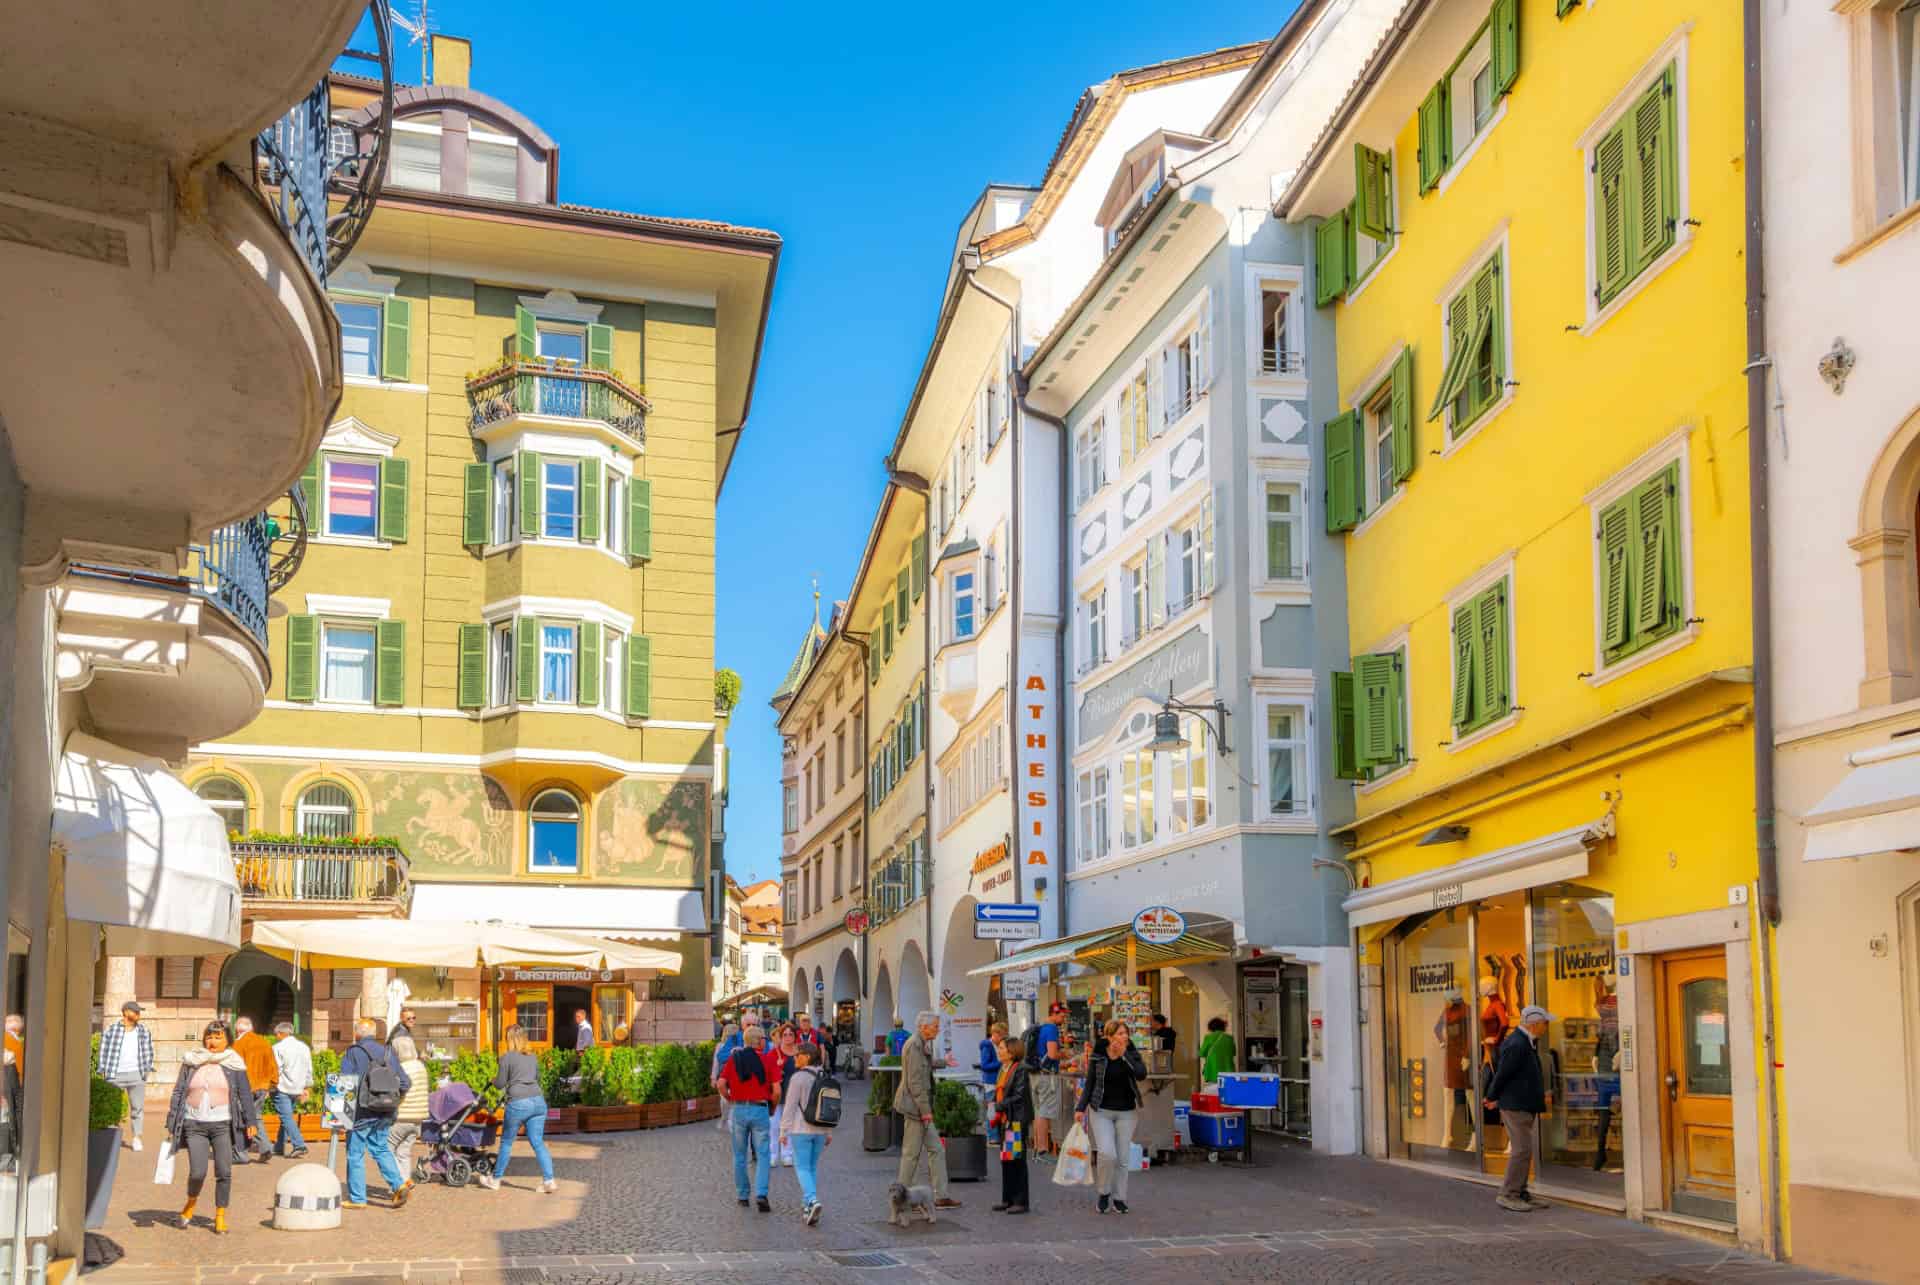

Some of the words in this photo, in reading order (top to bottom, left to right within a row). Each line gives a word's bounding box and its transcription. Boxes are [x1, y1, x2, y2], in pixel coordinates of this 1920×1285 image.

[1026, 676, 1048, 865] ATHESIA
[1566, 949, 1610, 970] Wolford
[1417, 970, 1447, 986] Wolford
